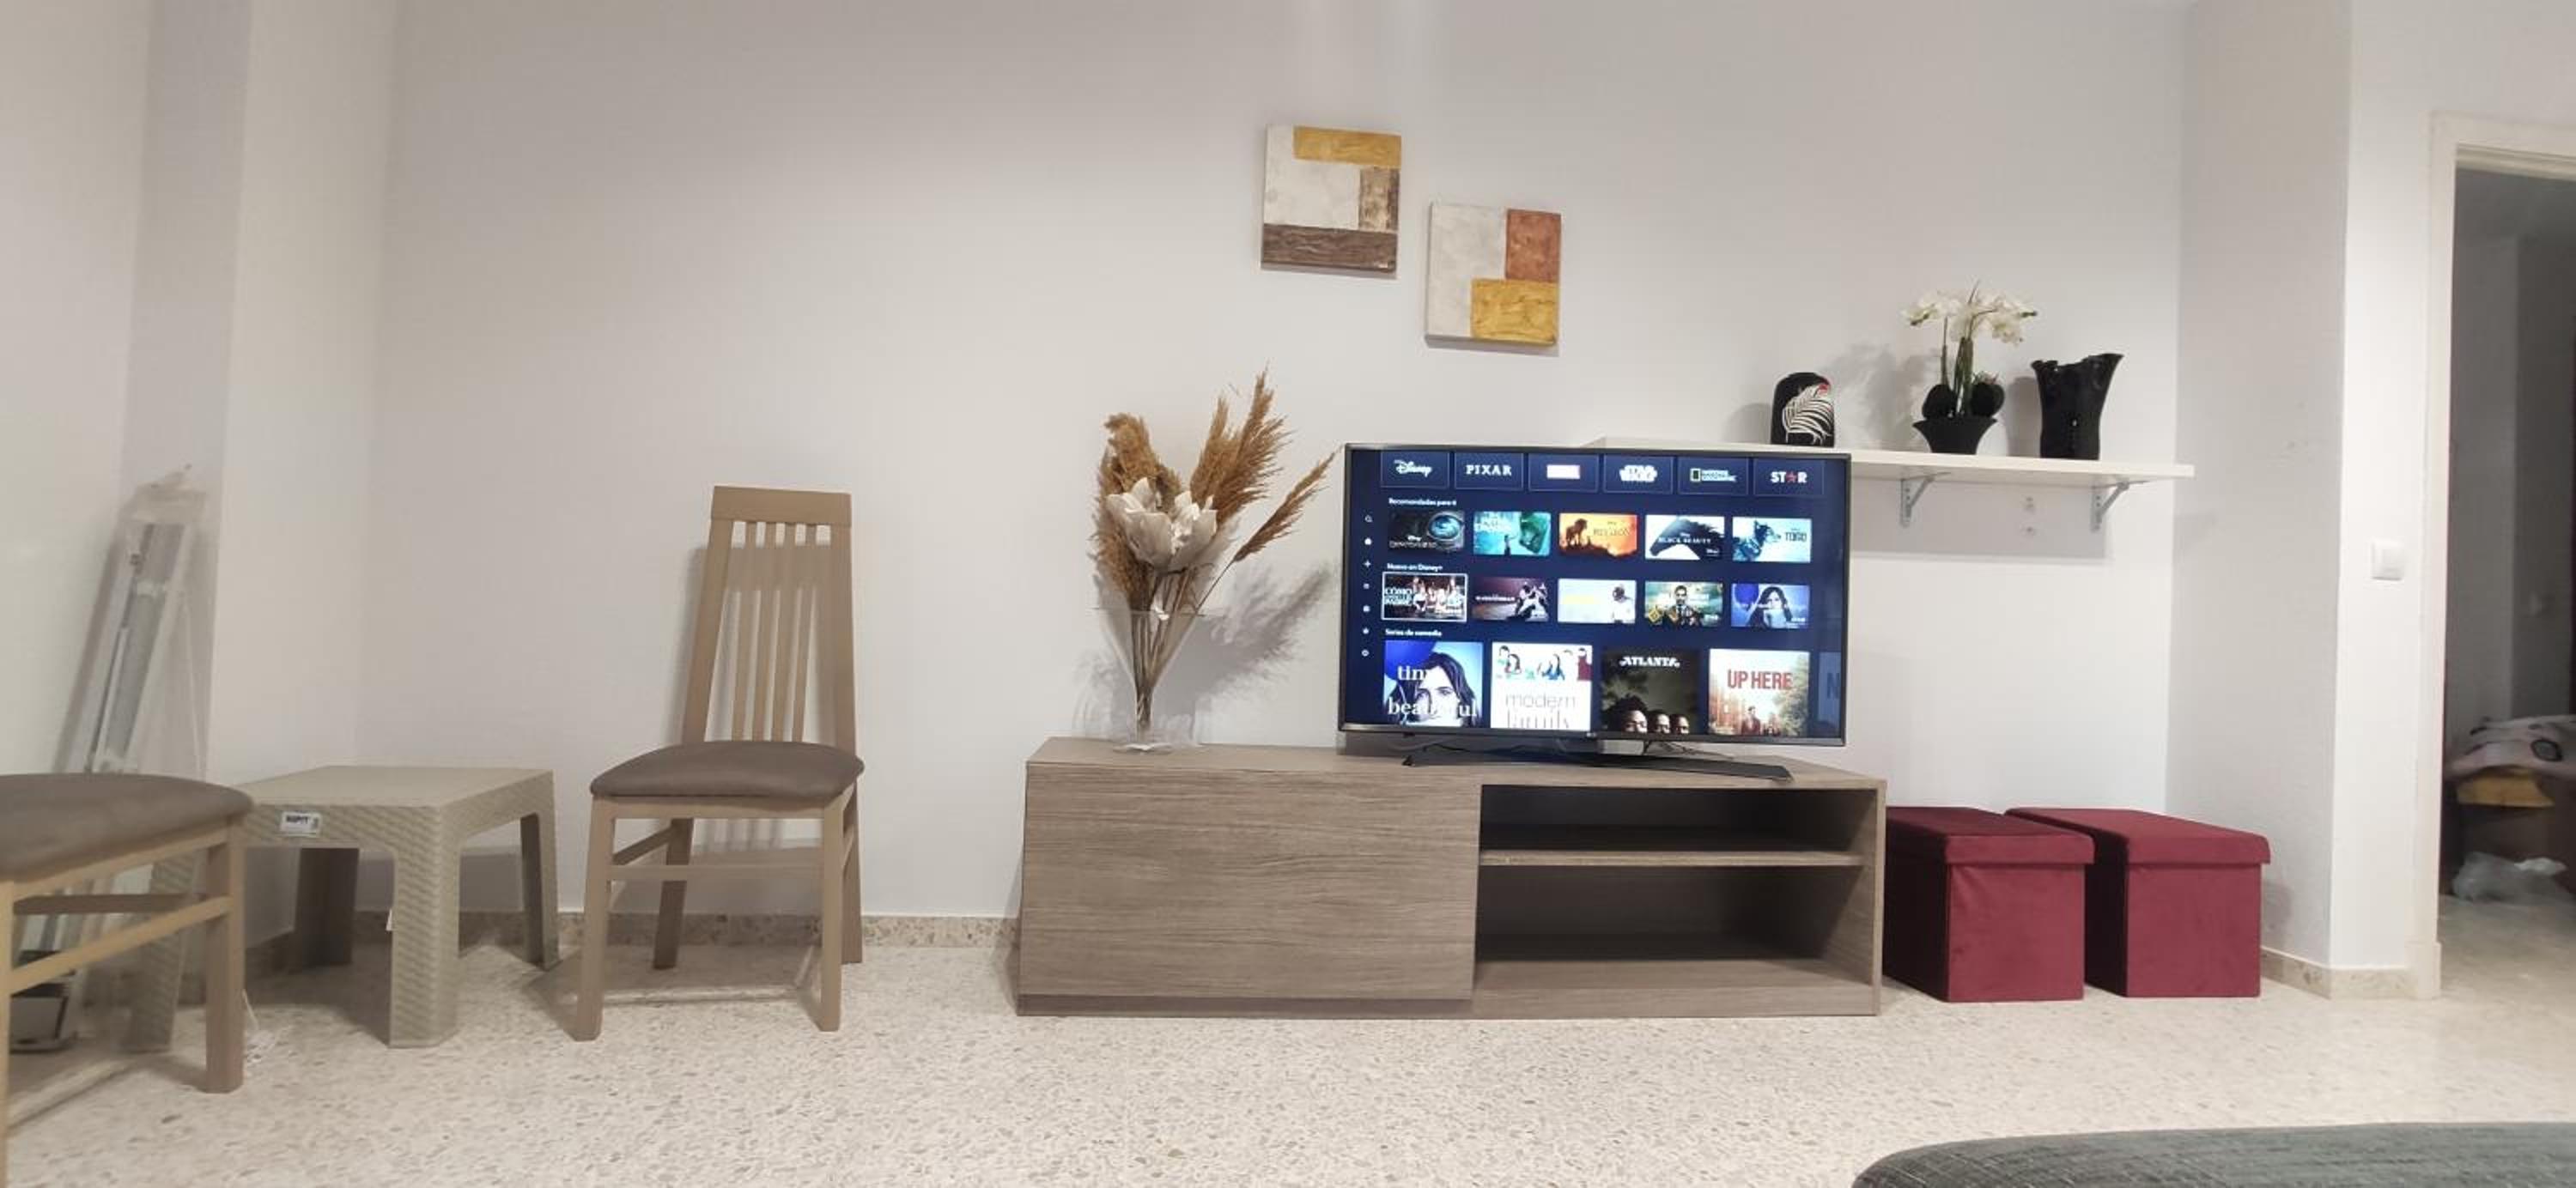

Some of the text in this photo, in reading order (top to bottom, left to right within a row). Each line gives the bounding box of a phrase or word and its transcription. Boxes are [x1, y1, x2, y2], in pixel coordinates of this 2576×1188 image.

[1394, 460, 1432, 477] Disney
[1466, 464, 1512, 476] PIXAR
[1728, 670, 1794, 690] UP HERE
[1505, 694, 1577, 709] modern
